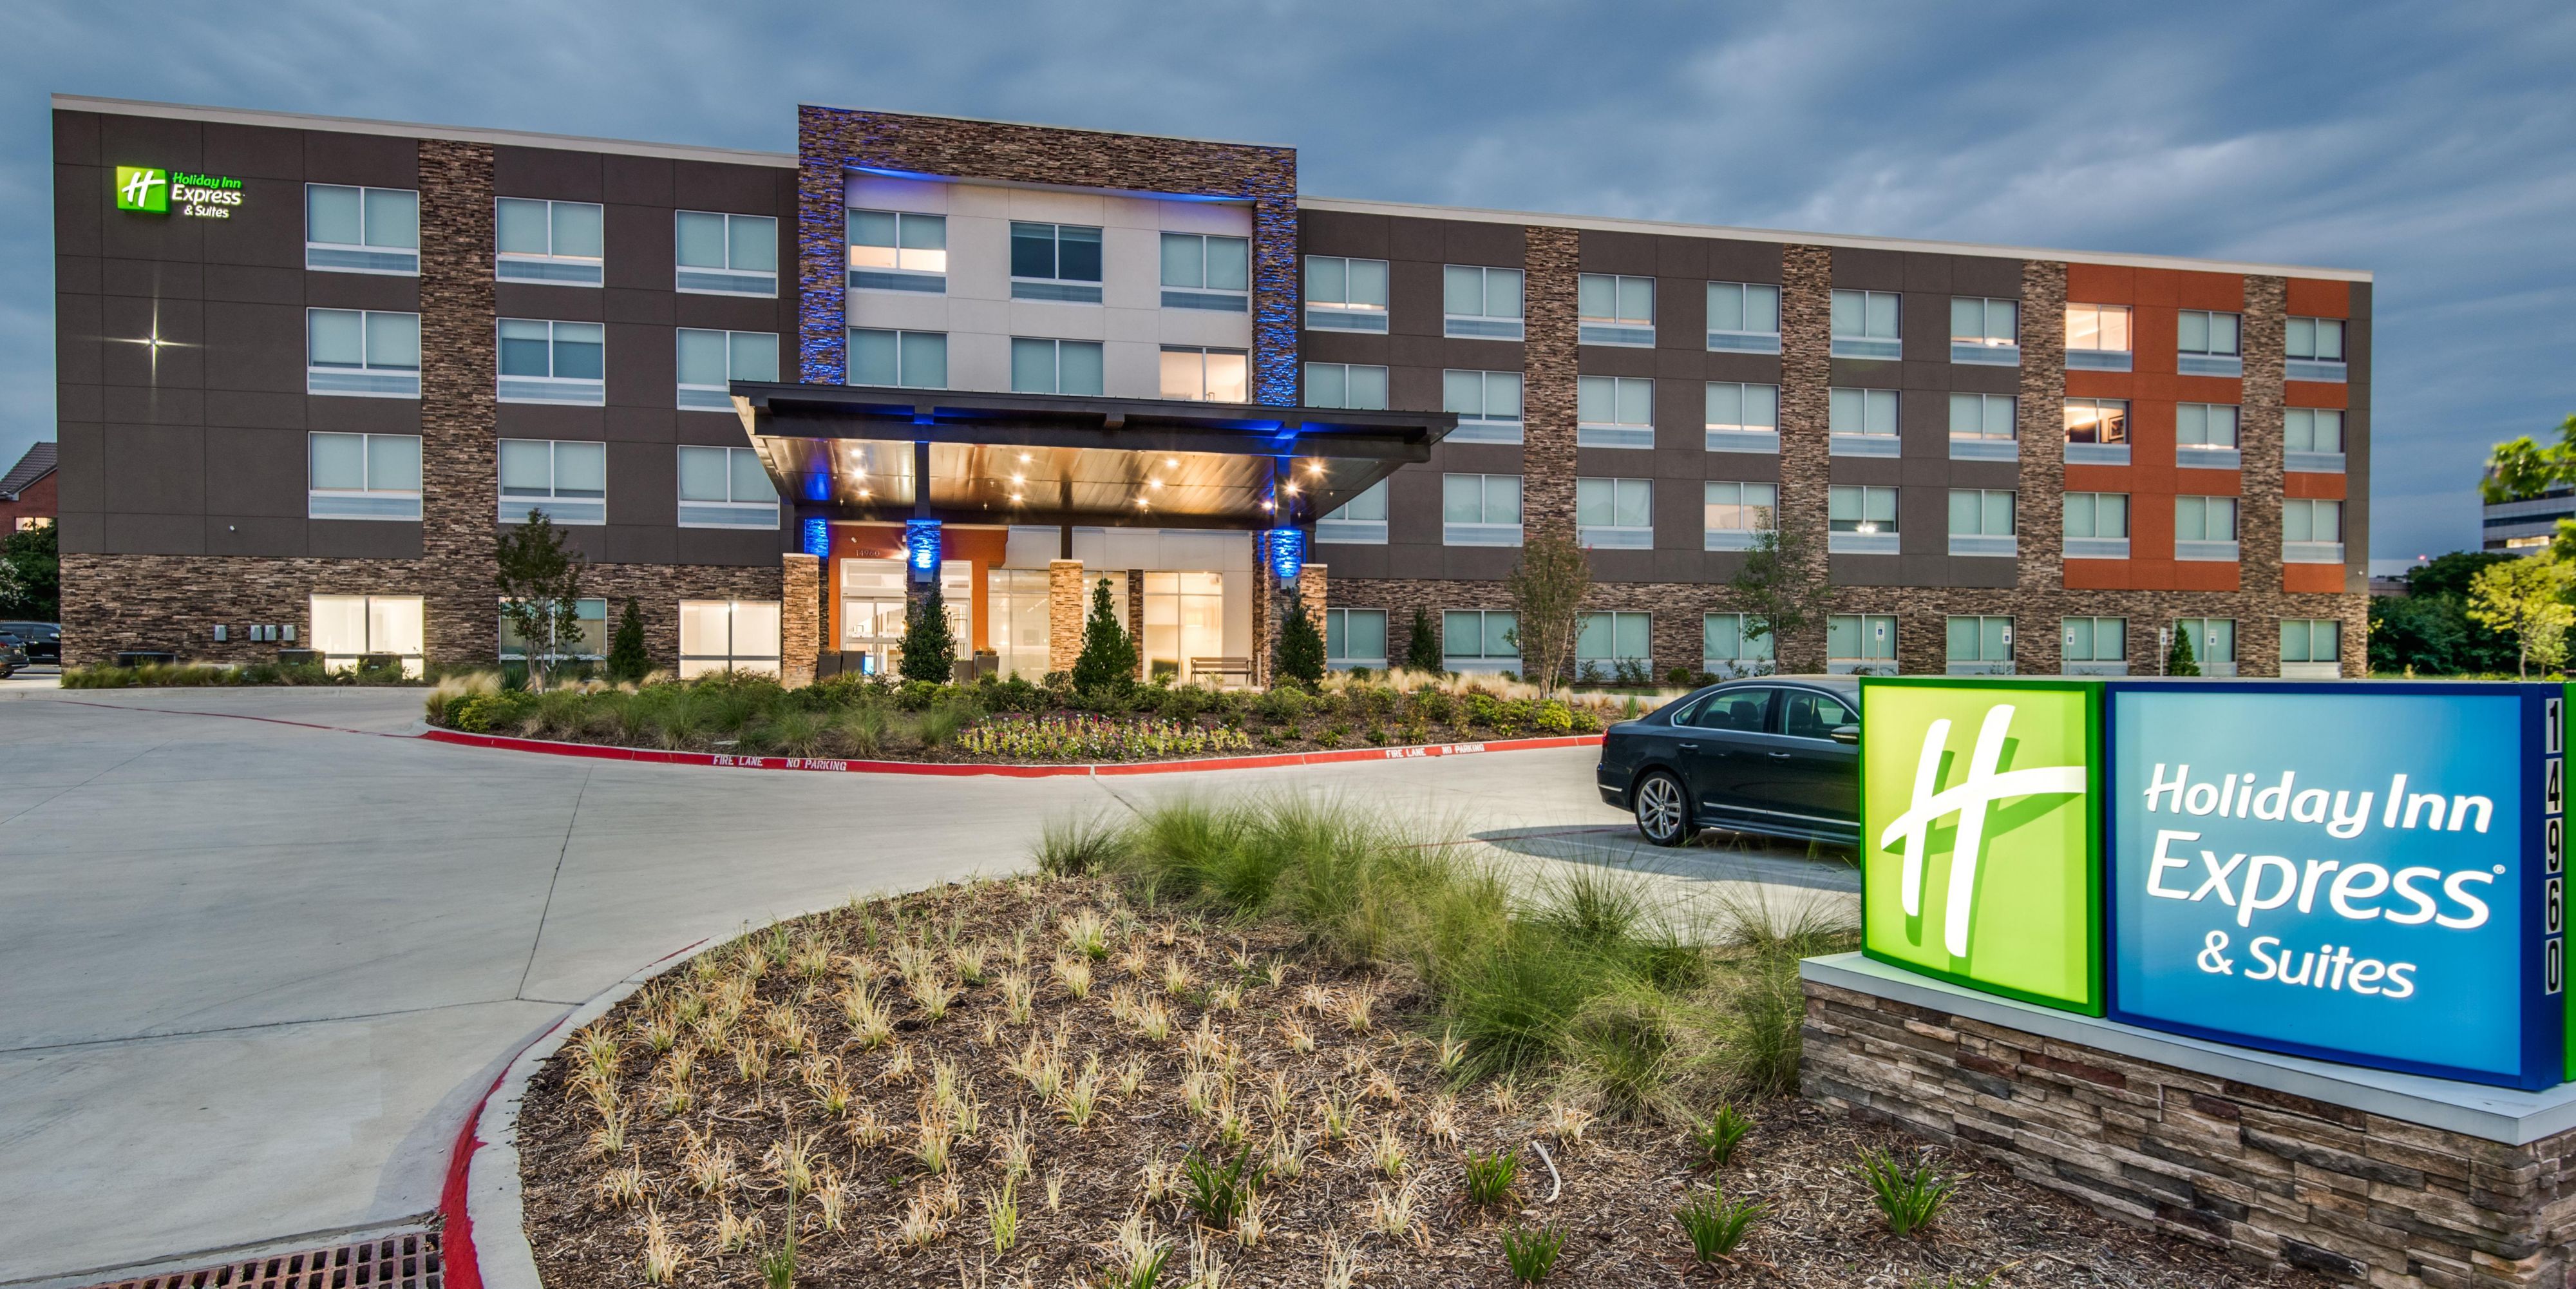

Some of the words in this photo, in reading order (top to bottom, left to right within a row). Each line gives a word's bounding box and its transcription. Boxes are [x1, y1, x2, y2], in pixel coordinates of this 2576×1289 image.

[173, 172, 220, 189] Holiday
[222, 177, 242, 188] Inn
[171, 184, 242, 205] Express
[184, 207, 194, 216] &
[194, 205, 229, 218] Suites
[1386, 749, 1404, 759] FIRE
[1406, 747, 1426, 757] LANE
[1442, 745, 1452, 754] NO
[1455, 743, 1485, 754] PARKING
[713, 755, 734, 765] FIRE
[739, 756, 764, 767] LANE
[786, 758, 800, 768] NO
[805, 759, 847, 771] PARKING
[2143, 763, 2374, 839] Holiday
[2383, 774, 2493, 833] Inn
[2548, 700, 2561, 992] 14960
[2197, 930, 2234, 975] &
[2244, 936, 2417, 998] Suites
